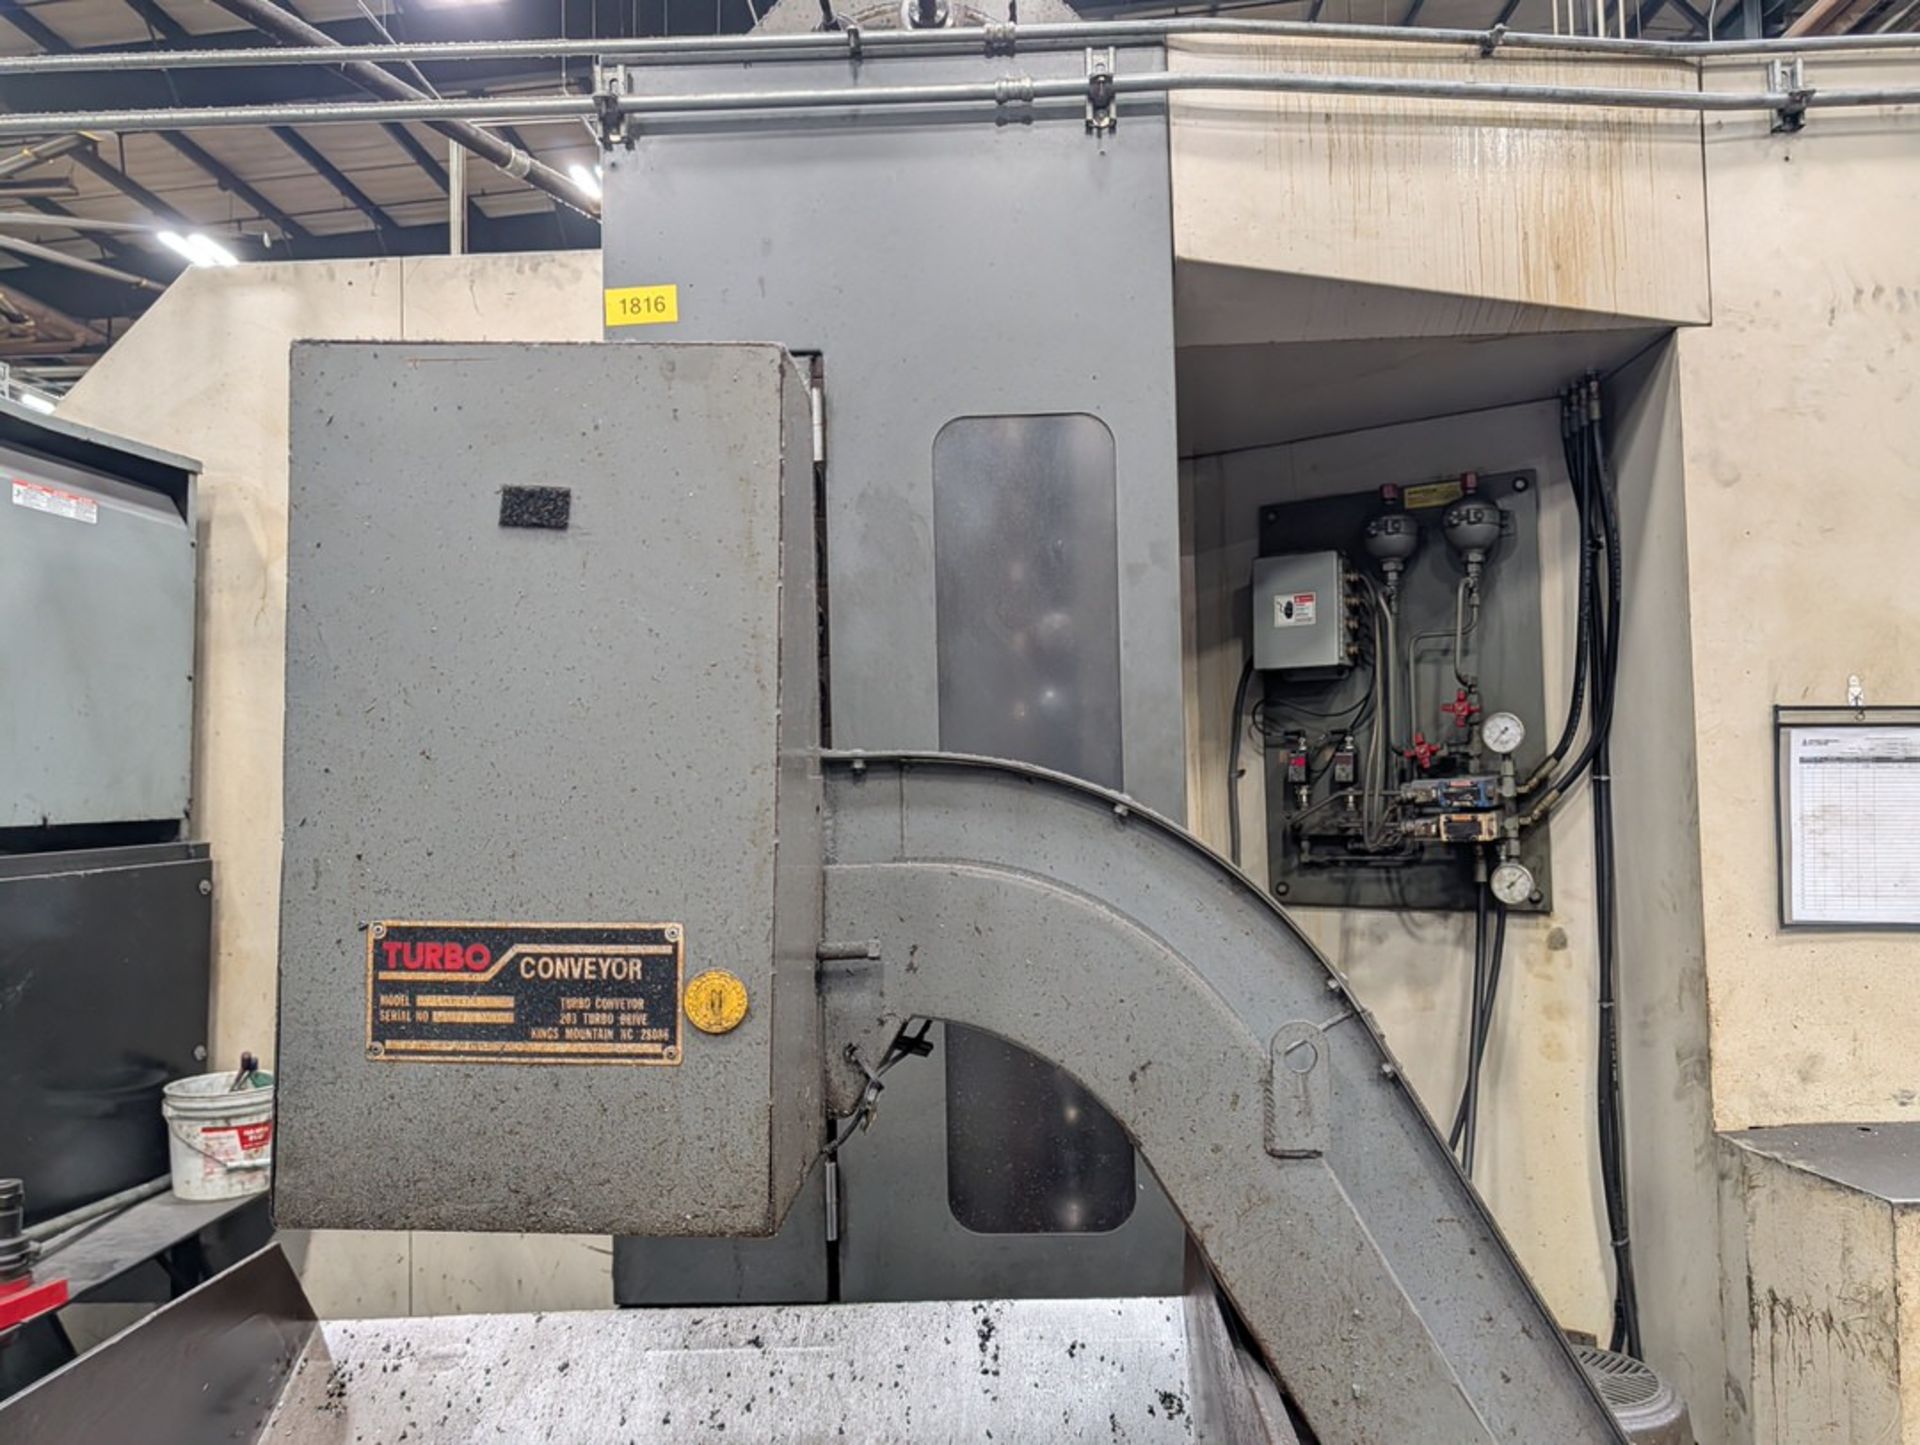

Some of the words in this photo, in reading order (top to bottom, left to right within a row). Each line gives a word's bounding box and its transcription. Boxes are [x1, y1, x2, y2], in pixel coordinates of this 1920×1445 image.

[619, 295, 666, 315] 1816
[382, 941, 491, 971] TURBO
[520, 956, 643, 980] CONVEYOR
[379, 994, 411, 1007] MODEL
[560, 996, 591, 1010] TURBO
[595, 996, 645, 1010] CONVEYOR
[379, 1010, 412, 1023] SERIAL
[583, 1013, 614, 1025] TURBO
[620, 1013, 648, 1026] DRIVE
[531, 1027, 559, 1039] KINGS
[564, 1027, 614, 1039] MOUNTAIN
